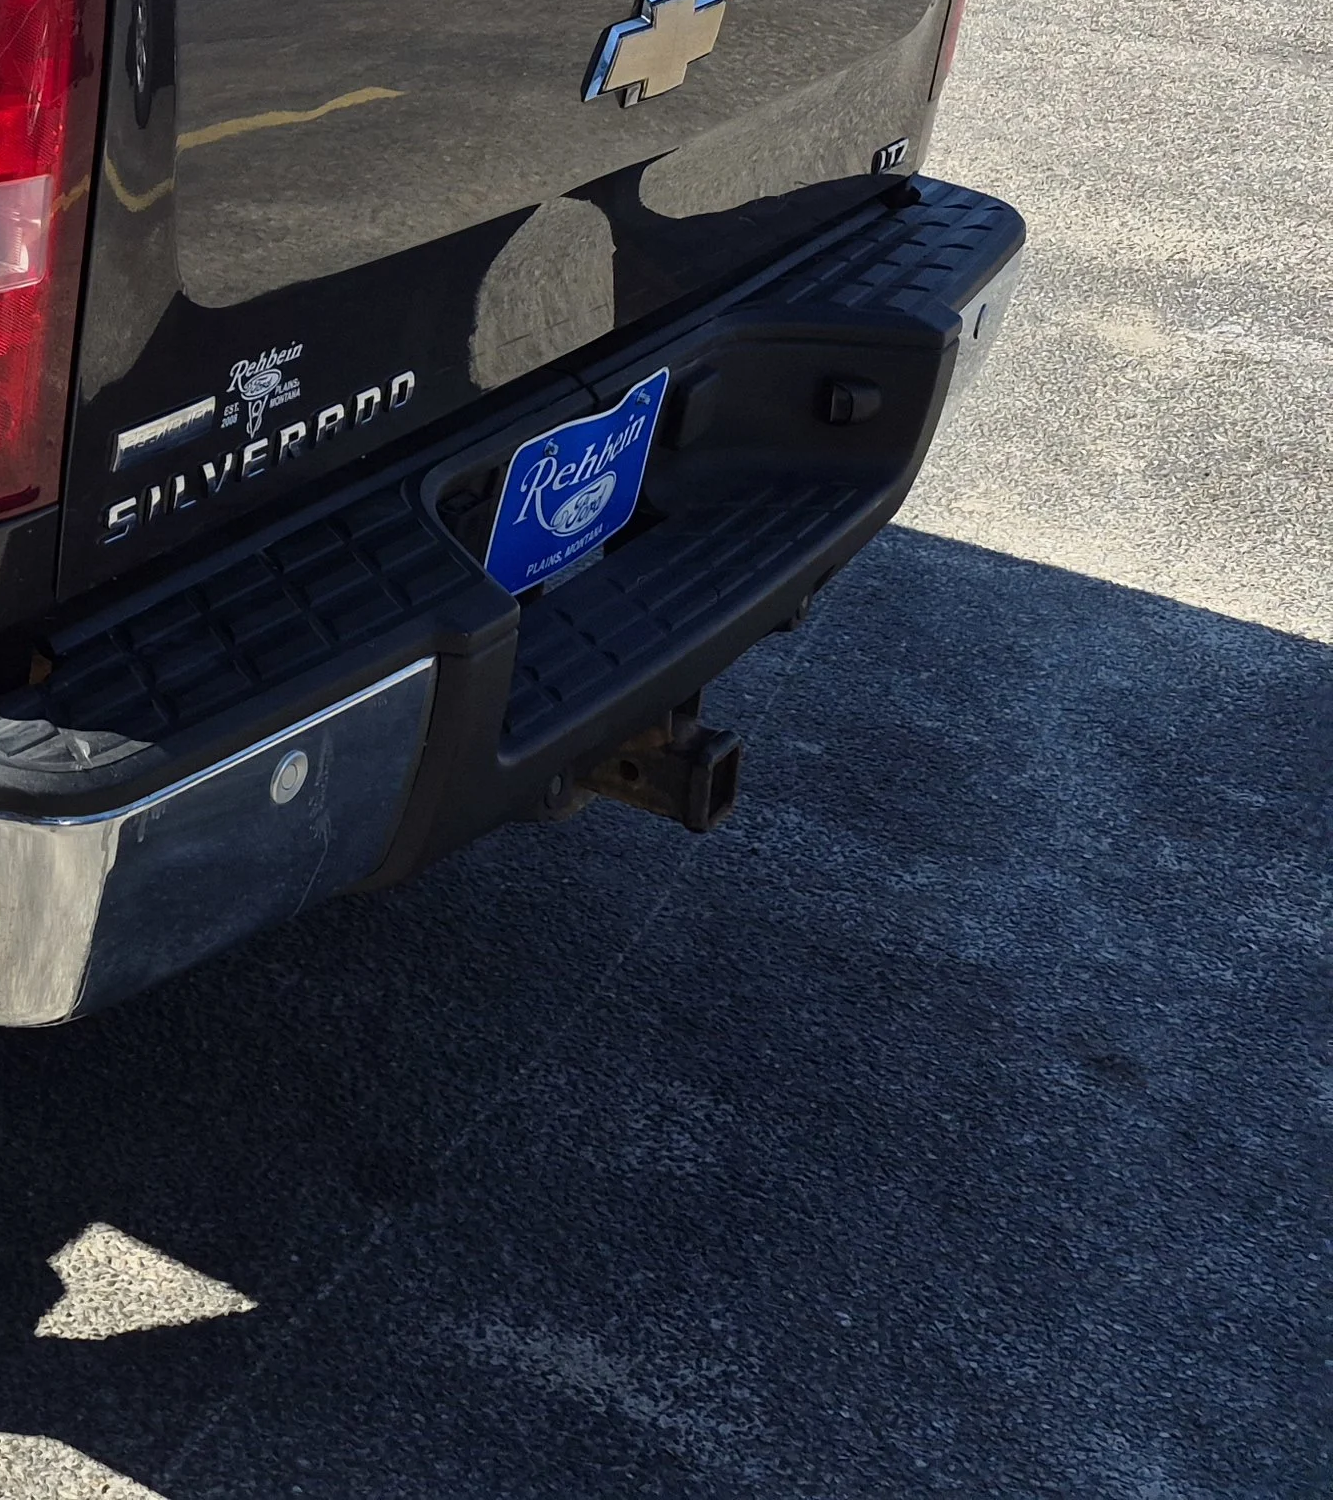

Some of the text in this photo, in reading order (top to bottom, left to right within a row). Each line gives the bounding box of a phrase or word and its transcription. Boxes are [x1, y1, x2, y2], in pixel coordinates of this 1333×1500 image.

[226, 341, 303, 392] Rehbein
[270, 387, 301, 408] MONTANA
[101, 369, 416, 545] SILVERADO
[512, 413, 646, 531] Rehbein
[526, 522, 605, 578] PLAINS, MONTANA
